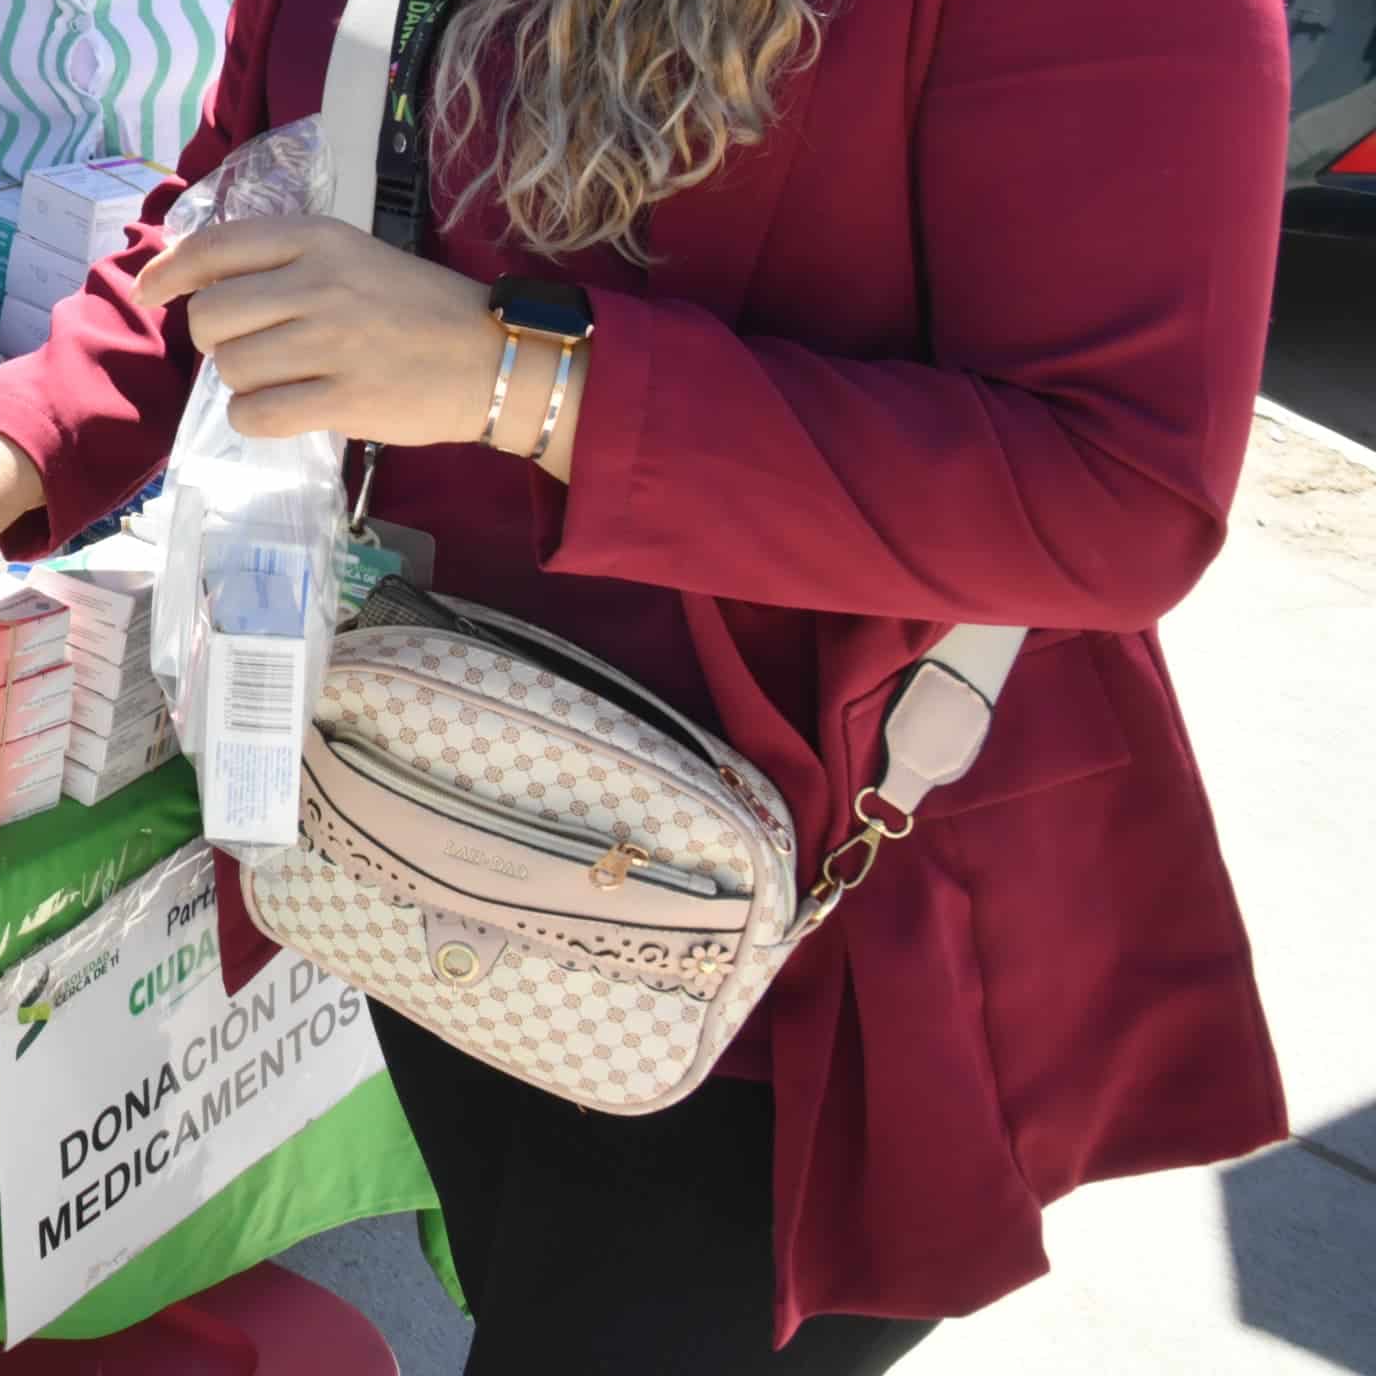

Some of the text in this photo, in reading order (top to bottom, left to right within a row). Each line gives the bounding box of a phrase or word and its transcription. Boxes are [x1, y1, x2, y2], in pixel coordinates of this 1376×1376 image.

[54, 977, 92, 1007] CERCA
[93, 964, 108, 982] DE
[128, 928, 218, 1016] CIUDA
[290, 959, 330, 1004] D
[37, 984, 360, 1258] MEDICAMENTOS
